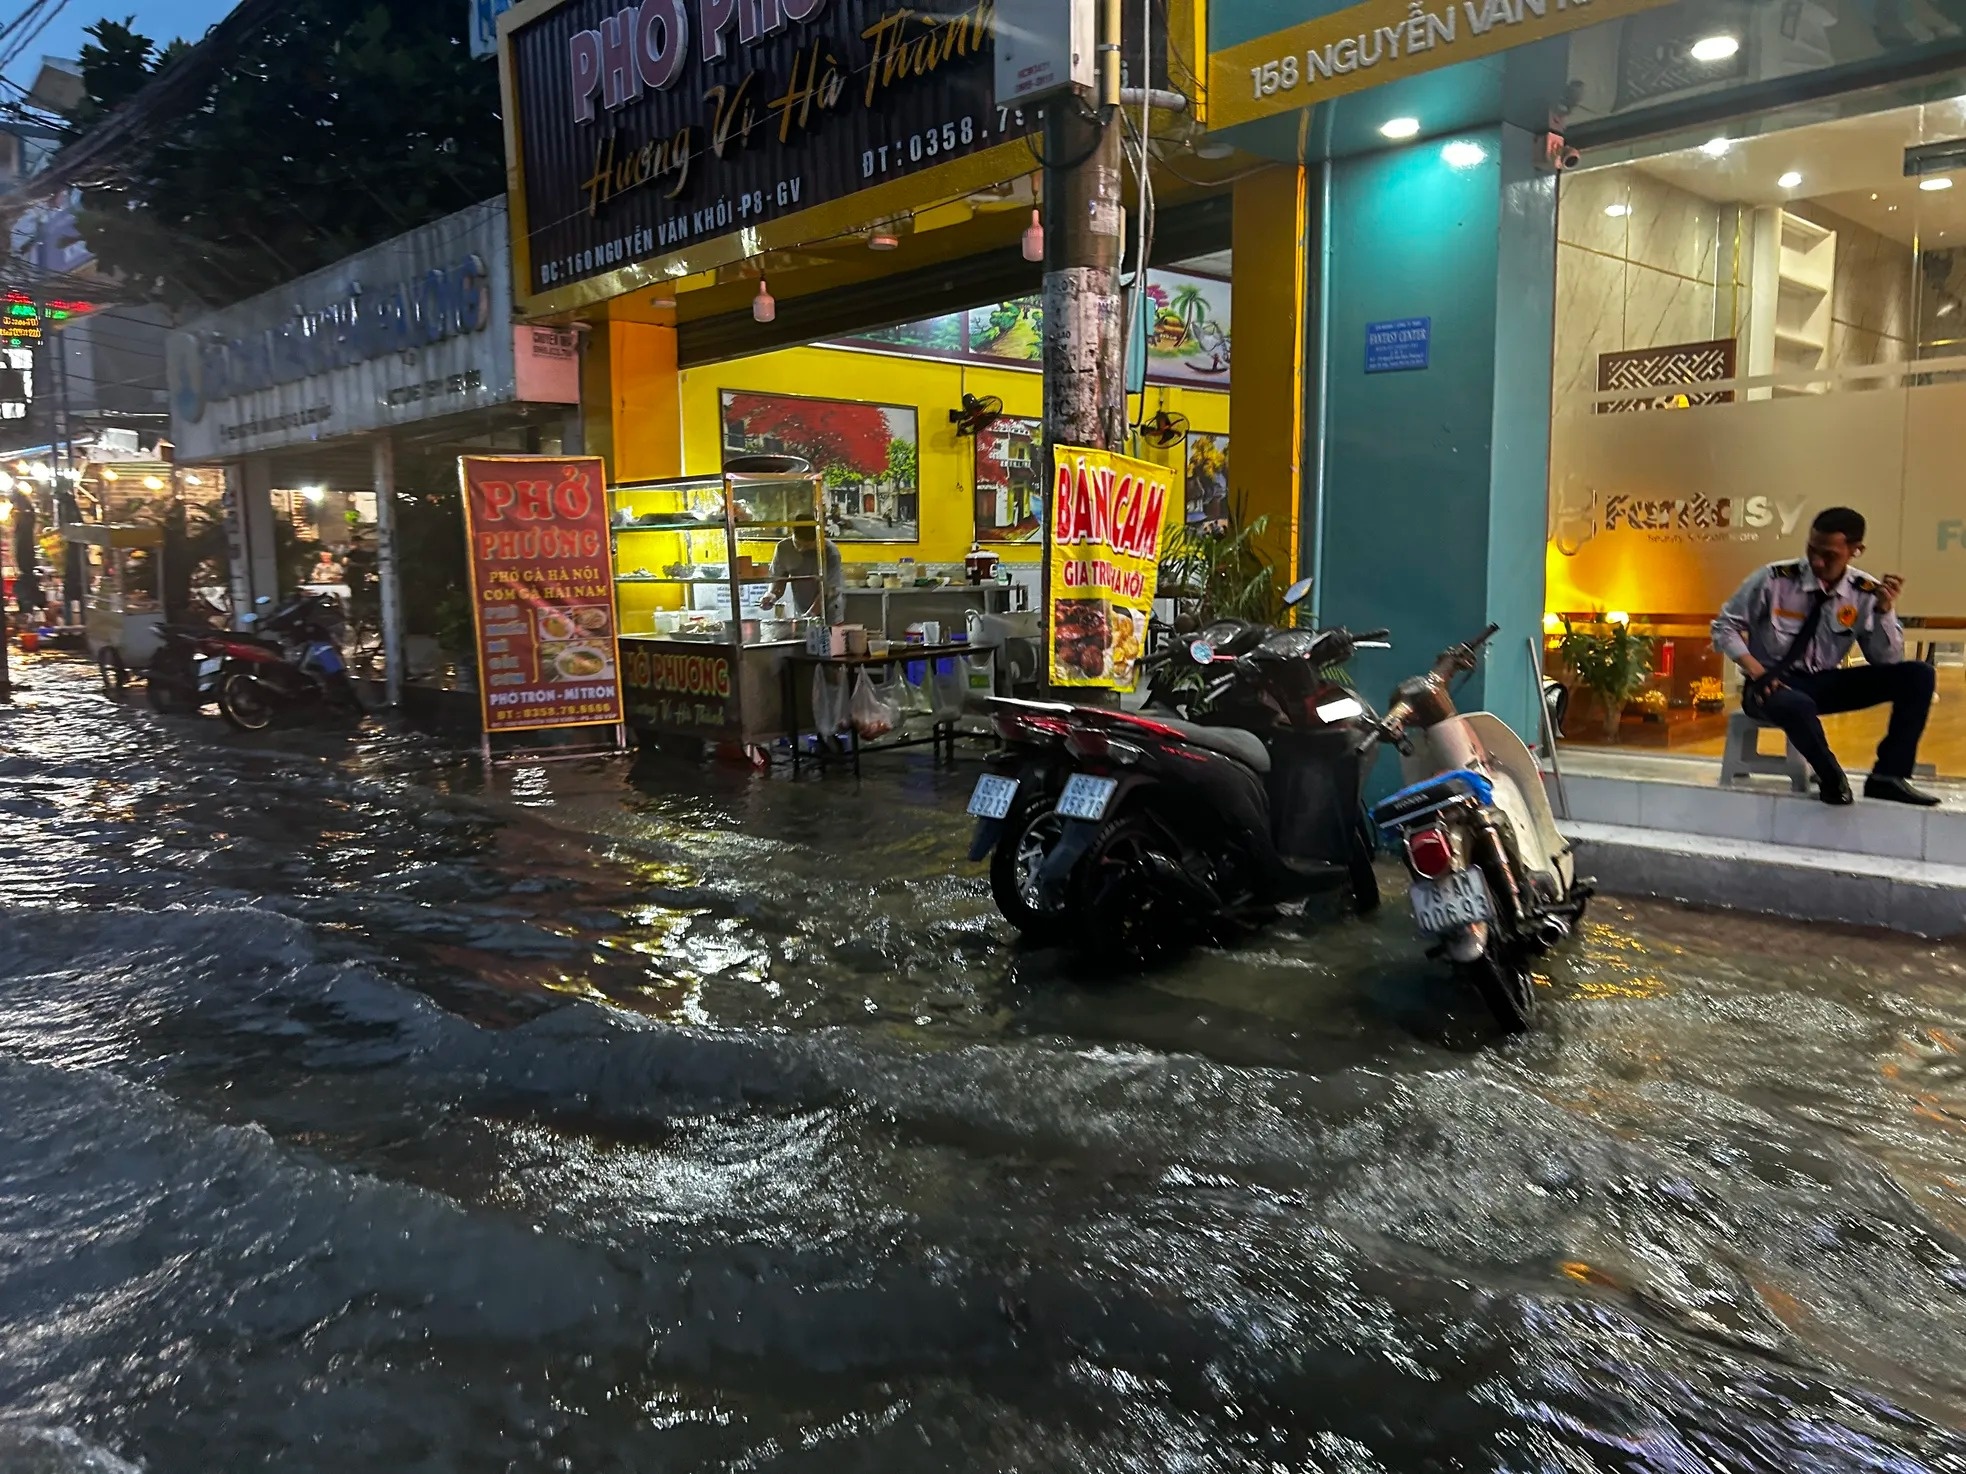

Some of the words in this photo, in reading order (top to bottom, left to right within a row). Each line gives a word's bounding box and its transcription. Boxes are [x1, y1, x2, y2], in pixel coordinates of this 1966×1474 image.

[1251, 55, 1300, 99] 158
[657, 215, 689, 246] VĂN
[693, 194, 733, 235] KHỐI
[480, 464, 592, 522] PHỞ
[1054, 456, 1116, 546] BÁN
[1110, 473, 1166, 561] CAM
[479, 524, 600, 560] PHƯƠNG
[573, 584, 607, 598] NAM
[1063, 560, 1090, 587] GIA
